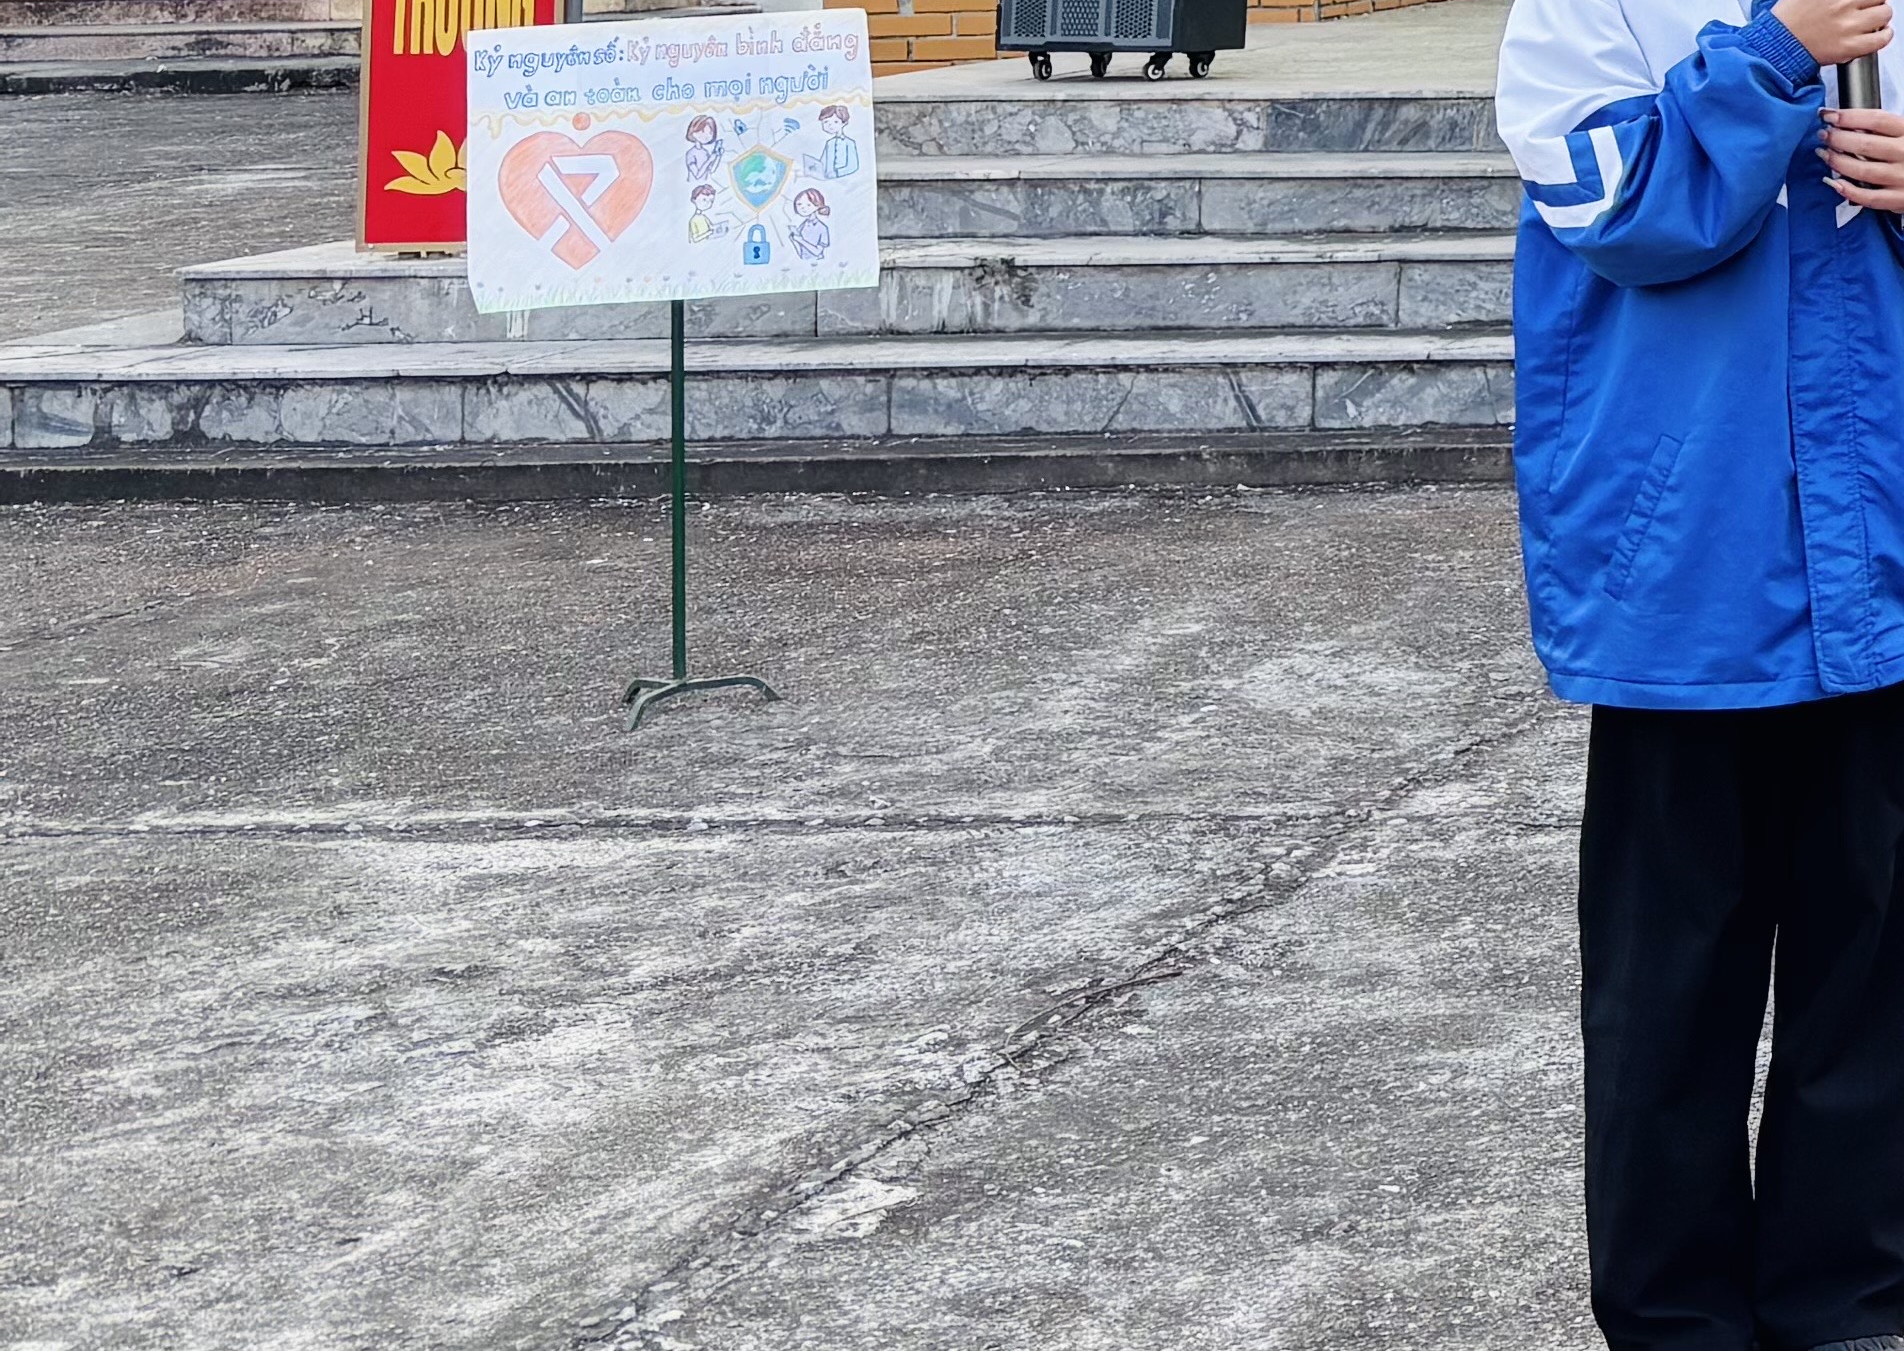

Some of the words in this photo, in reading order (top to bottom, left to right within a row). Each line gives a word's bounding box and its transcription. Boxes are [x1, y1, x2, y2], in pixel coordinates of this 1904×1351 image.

[474, 44, 503, 78] Kỷ
[627, 36, 652, 65] Kỷ
[655, 34, 729, 68] nguyên
[735, 26, 784, 57] bình
[504, 84, 539, 110] và
[544, 89, 577, 107] an
[584, 76, 642, 105] toàn
[651, 76, 696, 102] cho
[703, 71, 752, 102] mọi
[758, 63, 830, 104] người
